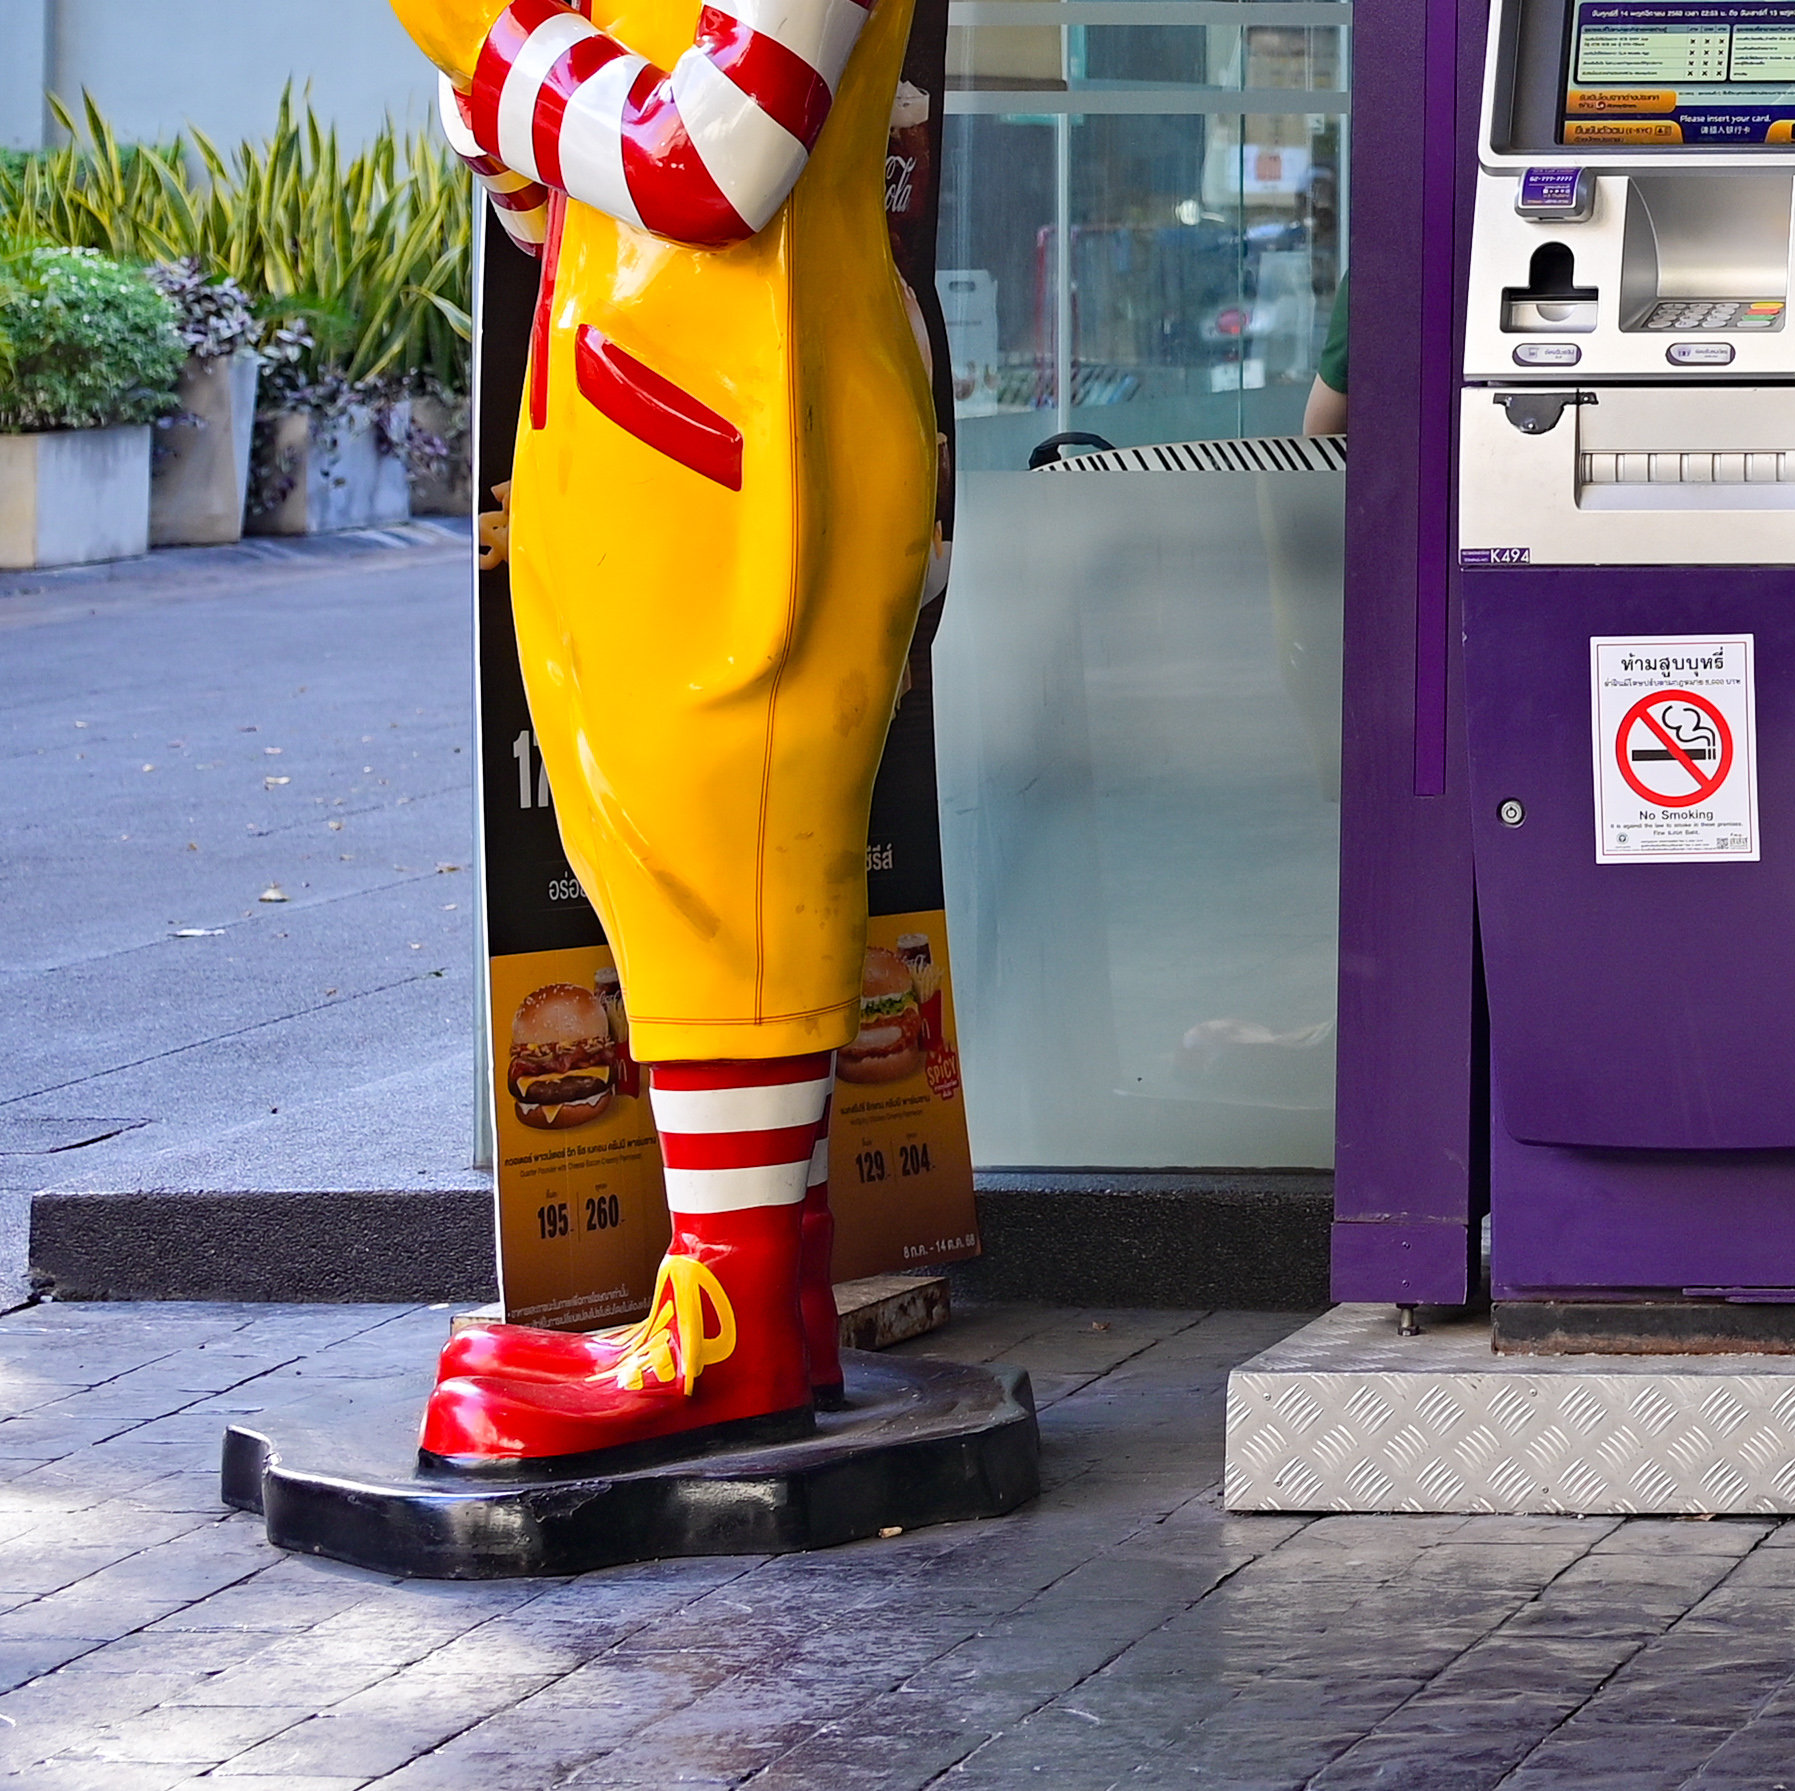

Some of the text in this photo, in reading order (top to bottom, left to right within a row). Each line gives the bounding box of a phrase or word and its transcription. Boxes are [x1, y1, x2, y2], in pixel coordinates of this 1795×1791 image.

[1680, 115, 1705, 123] Please
[1707, 114, 1730, 123] insert
[1731, 116, 1749, 125] your
[1491, 549, 1529, 563] K494
[1621, 646, 1724, 677] ห้ามสูบบุหรี่
[1640, 809, 1714, 821] No Smoking
[926, 1056, 956, 1086] SPICY
[936, 1239, 946, 1252] 14
